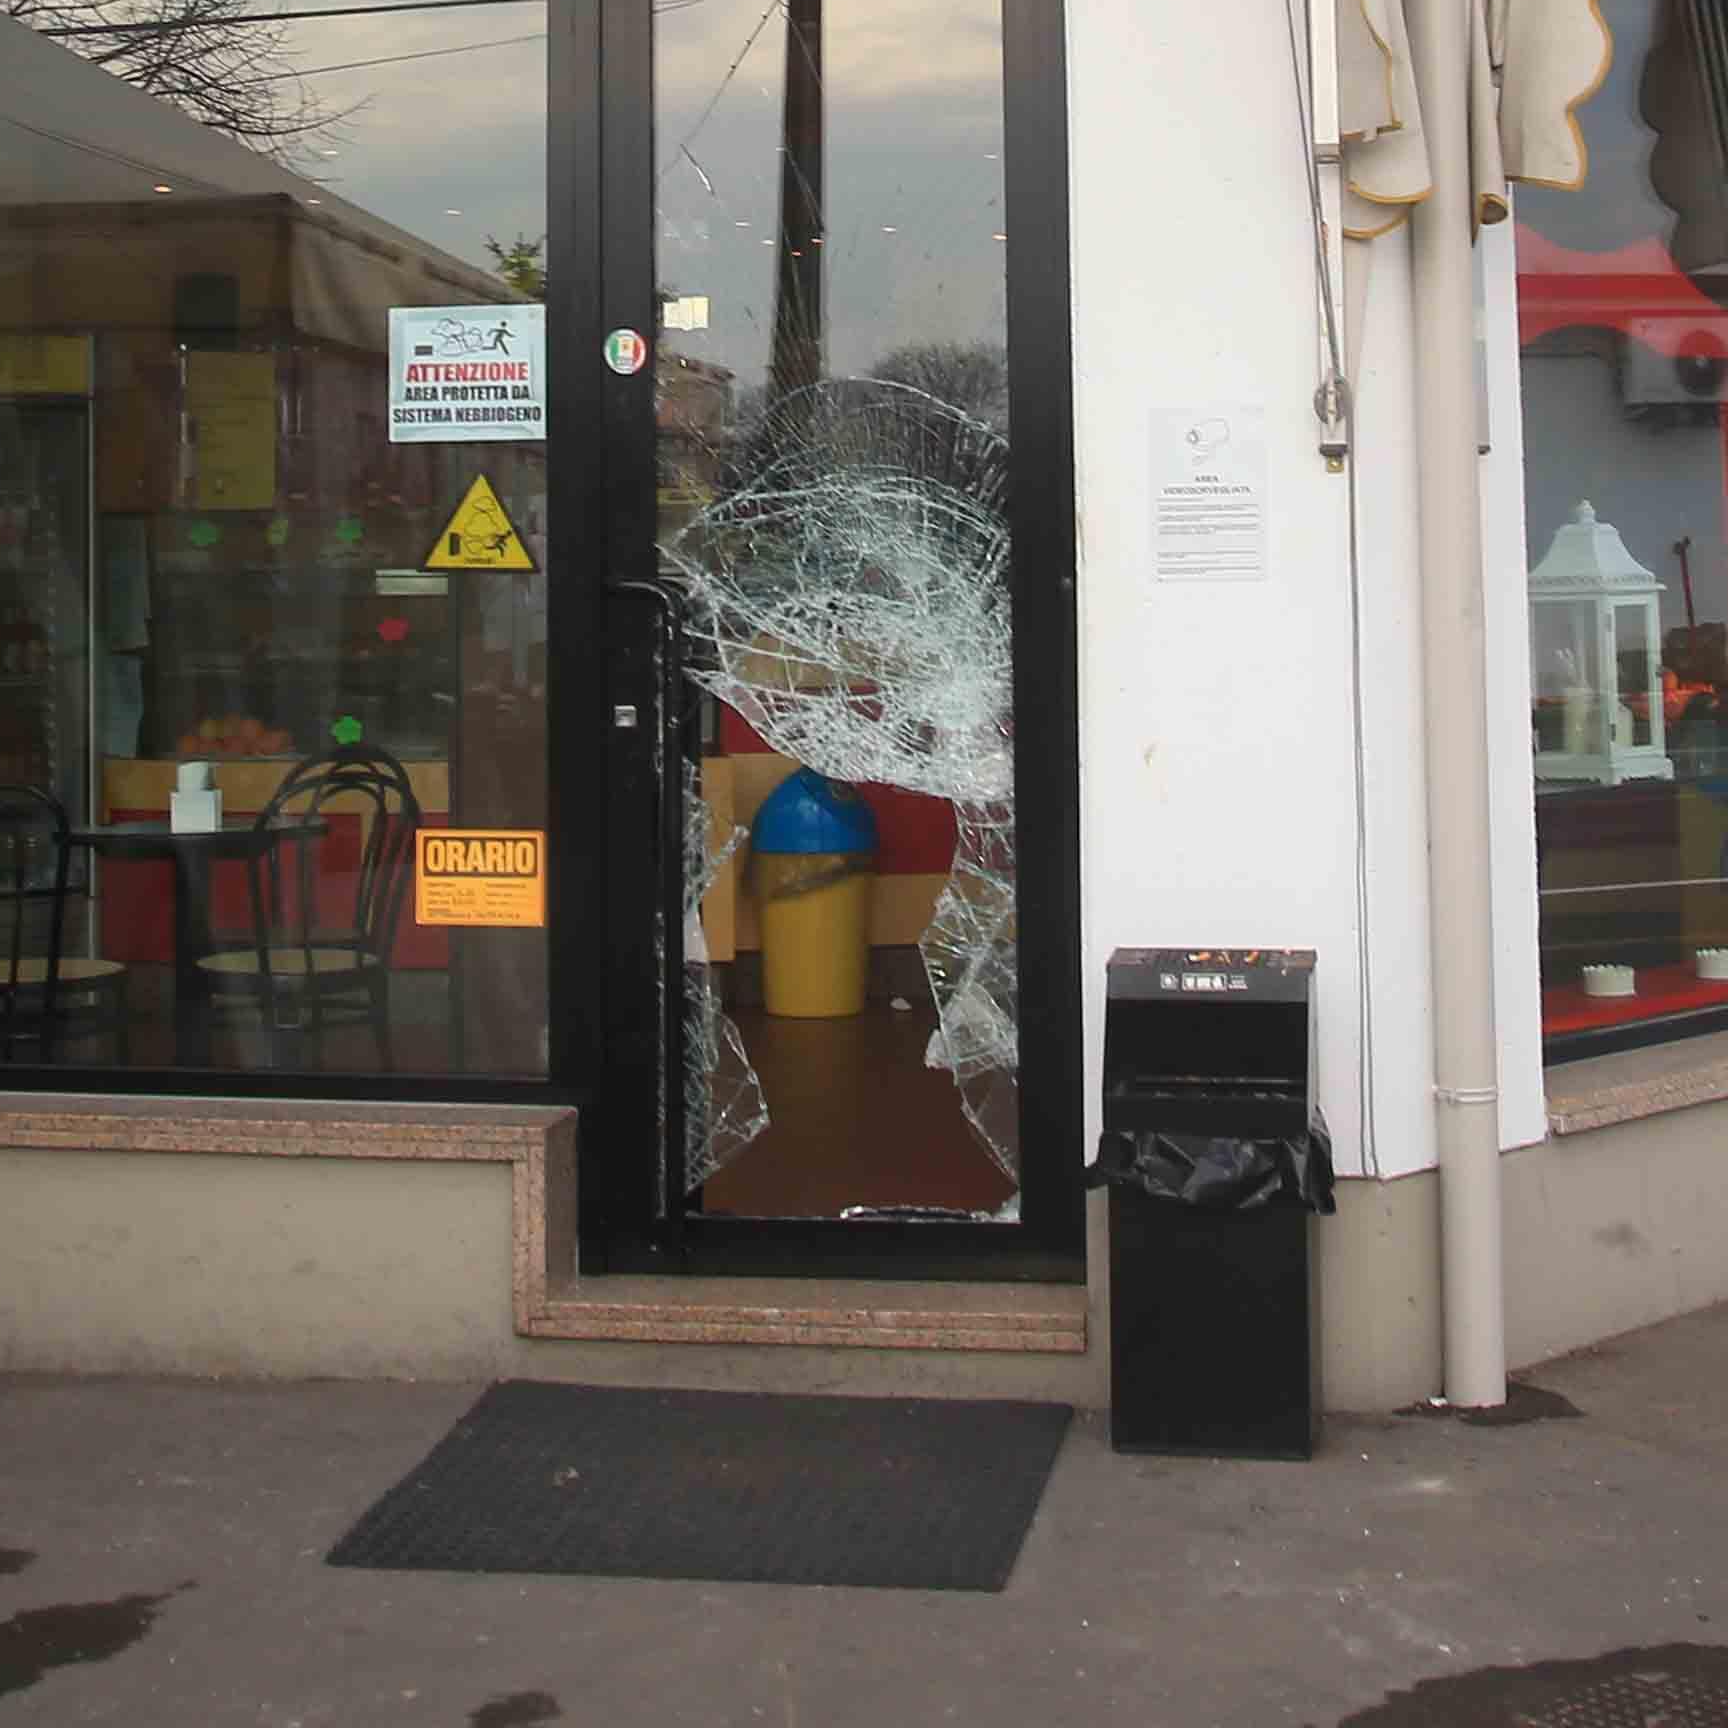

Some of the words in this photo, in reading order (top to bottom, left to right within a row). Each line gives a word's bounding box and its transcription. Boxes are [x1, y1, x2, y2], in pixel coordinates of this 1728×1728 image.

[406, 362, 529, 383] ATTENZIONE
[405, 386, 438, 401] AREA
[441, 385, 508, 401] PROTETTA
[512, 385, 530, 400] DA
[393, 407, 452, 423] SISTEMA
[455, 406, 542, 423] NEBBIOGENO
[427, 839, 536, 874] ORARIO
